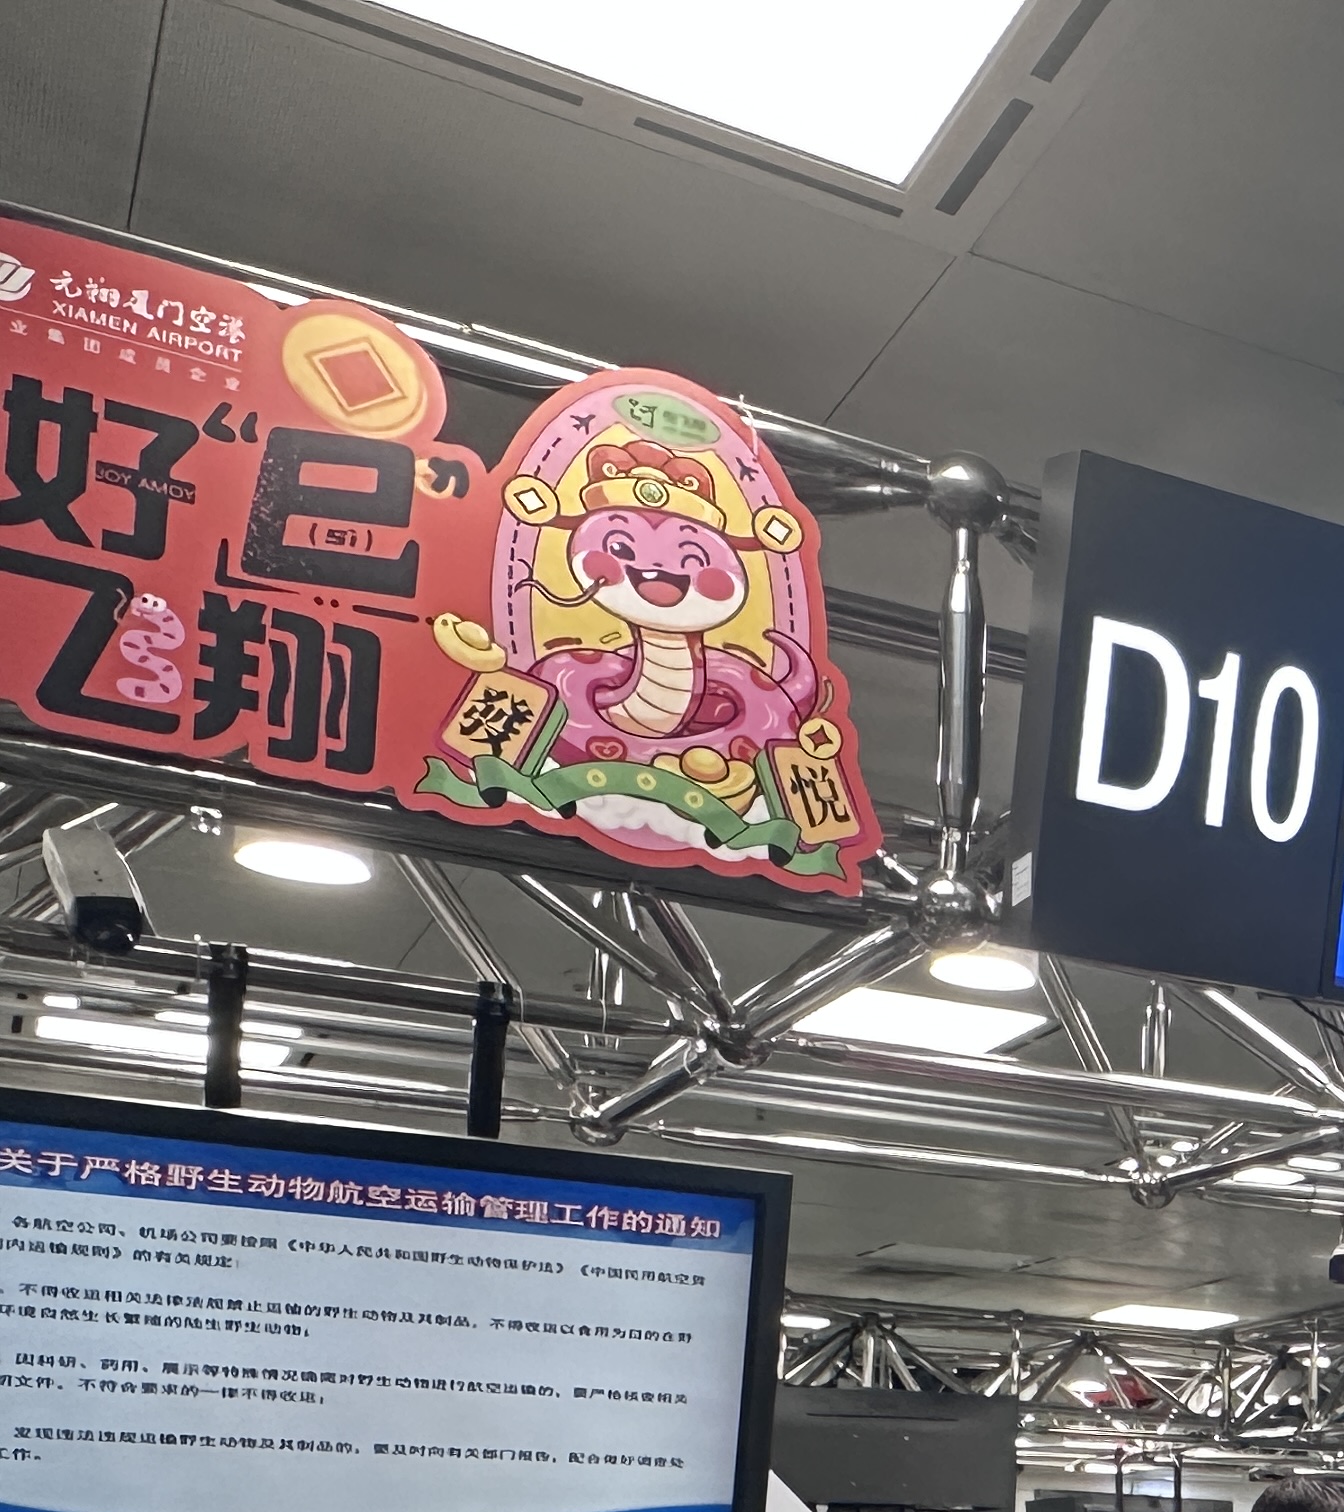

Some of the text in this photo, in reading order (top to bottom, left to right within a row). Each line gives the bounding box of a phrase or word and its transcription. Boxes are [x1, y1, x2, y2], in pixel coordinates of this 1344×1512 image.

[52, 300, 243, 362] XIAMEN AIRPORT
[97, 466, 196, 501] JOY AMOY
[1076, 616, 1319, 842] D10
[0, 1147, 721, 1239] 关于严格野生动物航空运输管理工作的通知
